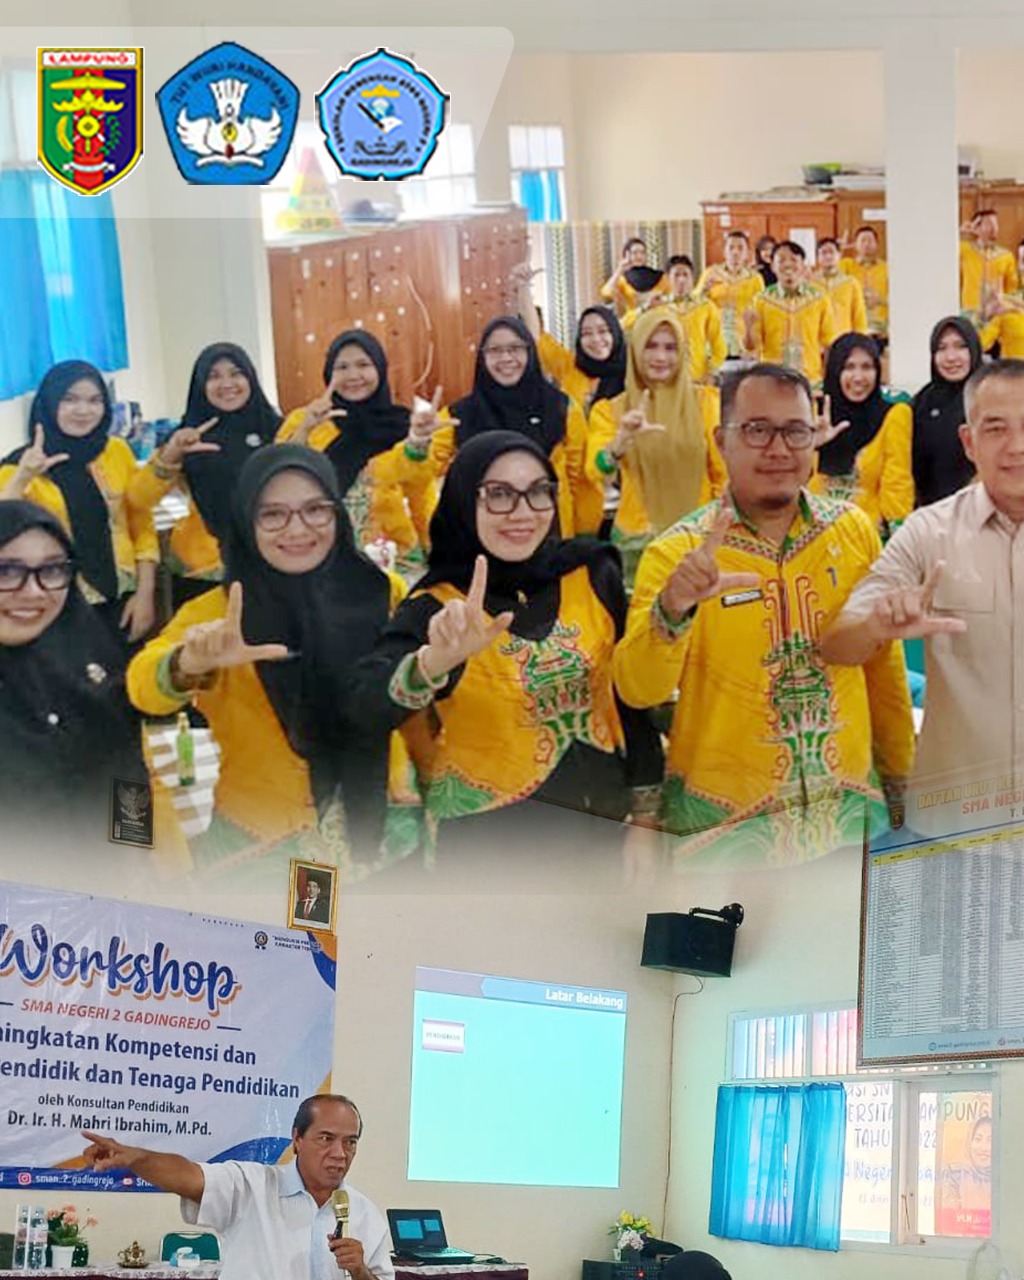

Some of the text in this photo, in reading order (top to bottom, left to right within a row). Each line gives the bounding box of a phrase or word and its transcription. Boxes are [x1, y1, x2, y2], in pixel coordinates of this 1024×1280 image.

[962, 799, 990, 815] SMA
[0, 923, 241, 1015] Workshop
[546, 988, 623, 1009] Latar Belakang
[21, 998, 211, 1031] SMA NEGERI 2 GADINGREJO
[0, 1022, 256, 1065] ingkatan Kompetensi dan
[0, 1058, 300, 1098] endidik dan Tenaga Pendidikan
[38, 1094, 189, 1114] oleh Konsultan Pendidikan
[919, 1101, 989, 1122] AMPUNG
[8, 1110, 212, 1136] Dr. Ir. H. Mahri Ibrahim, M.Pd.
[855, 1128, 890, 1148] TAHU
